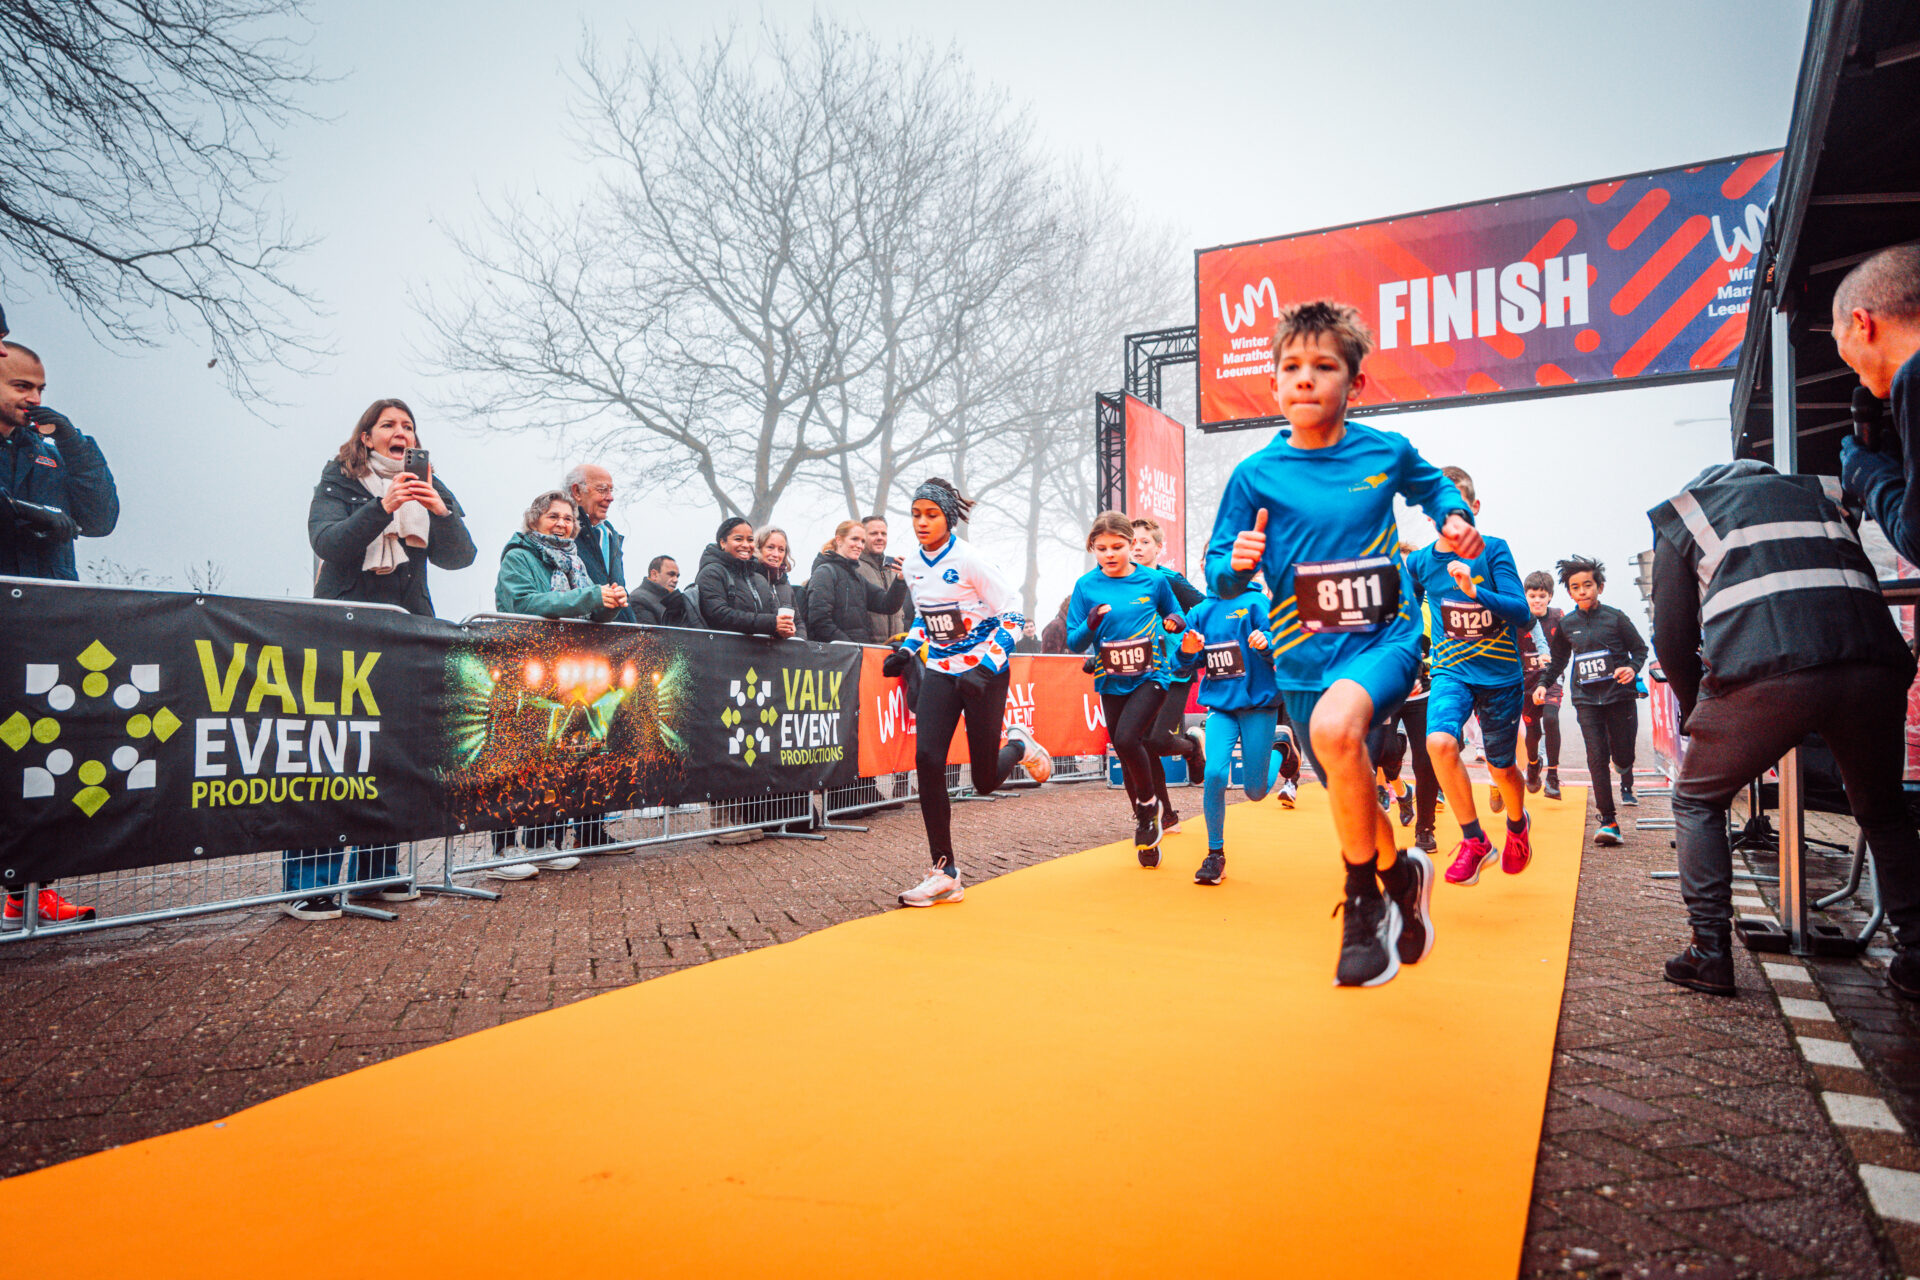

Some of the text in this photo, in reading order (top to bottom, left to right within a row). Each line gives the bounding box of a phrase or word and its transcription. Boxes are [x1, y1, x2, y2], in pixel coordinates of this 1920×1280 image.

[1728, 267, 1757, 282] Win
[1379, 253, 1589, 350] FINISH
[1231, 336, 1270, 350] Winter
[1216, 360, 1276, 380] Leeuwarde
[1153, 467, 1177, 497] VALK
[1153, 490, 1177, 514] EVENT
[1316, 573, 1383, 612] 8111
[1449, 609, 1493, 629] 8120
[1109, 646, 1145, 666] 8119
[1206, 650, 1234, 669] 8110
[1578, 658, 1607, 675] 8113
[195, 639, 383, 716] VALK
[782, 667, 843, 711] VALK
[1004, 682, 1035, 707] ALK
[1002, 707, 1035, 728] VENT
[780, 712, 841, 748] EVENT
[194, 717, 381, 778] EVENT
[780, 745, 844, 766] PRODUCTIONS
[191, 775, 379, 809] PRODUCTIONS
